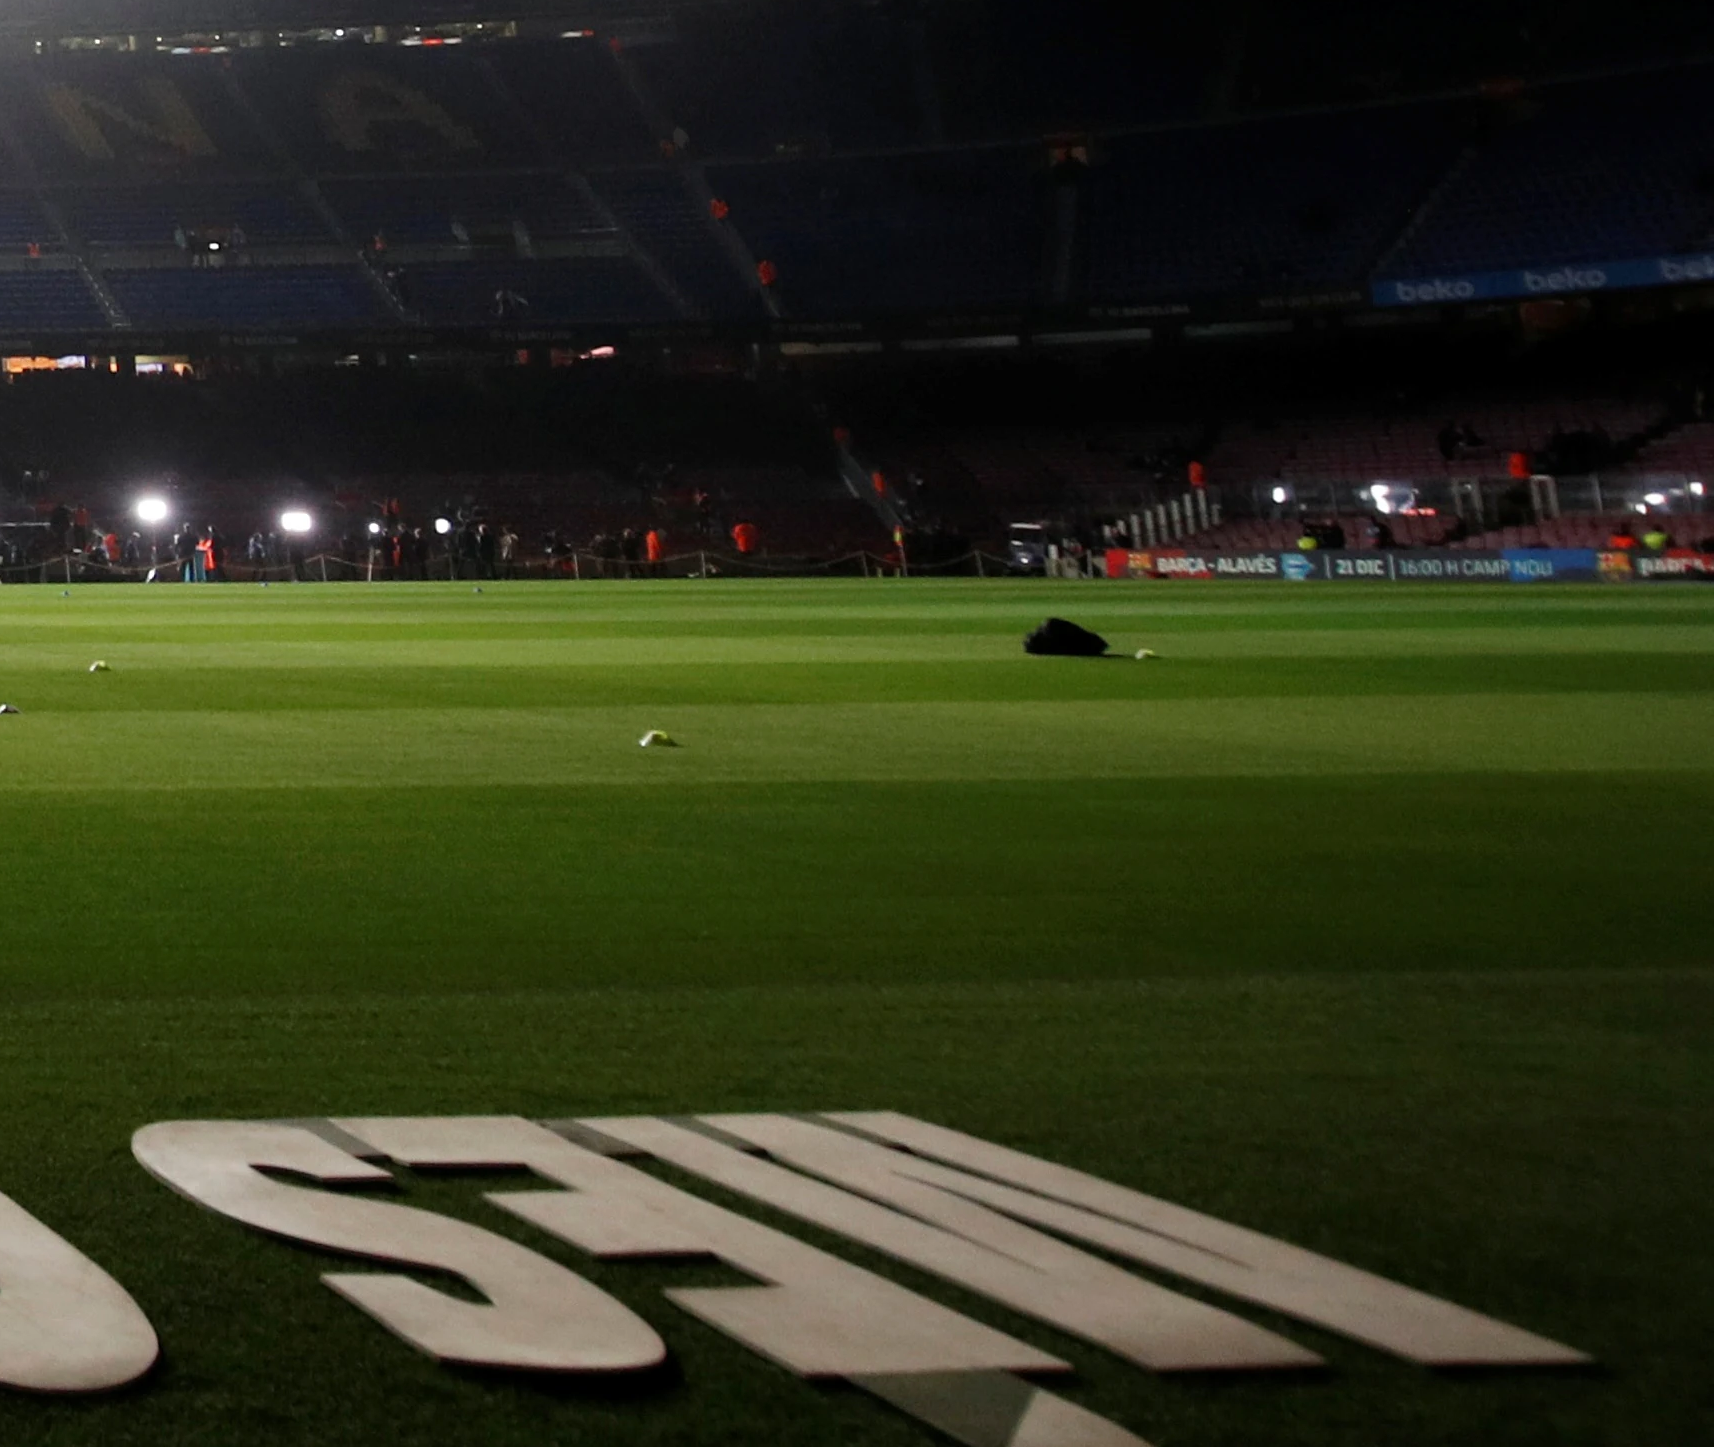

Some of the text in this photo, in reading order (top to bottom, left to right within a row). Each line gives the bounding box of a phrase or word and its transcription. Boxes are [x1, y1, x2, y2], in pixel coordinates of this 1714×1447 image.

[1396, 279, 1474, 303] beko
[1524, 266, 1607, 292] beko
[1156, 557, 1208, 575] BARÇA
[1217, 553, 1277, 574] ALAVÉS
[1336, 559, 1353, 575] 21
[1357, 559, 1384, 575] DIC
[1462, 558, 1511, 576] CAMP
[1515, 559, 1553, 576] NOU
